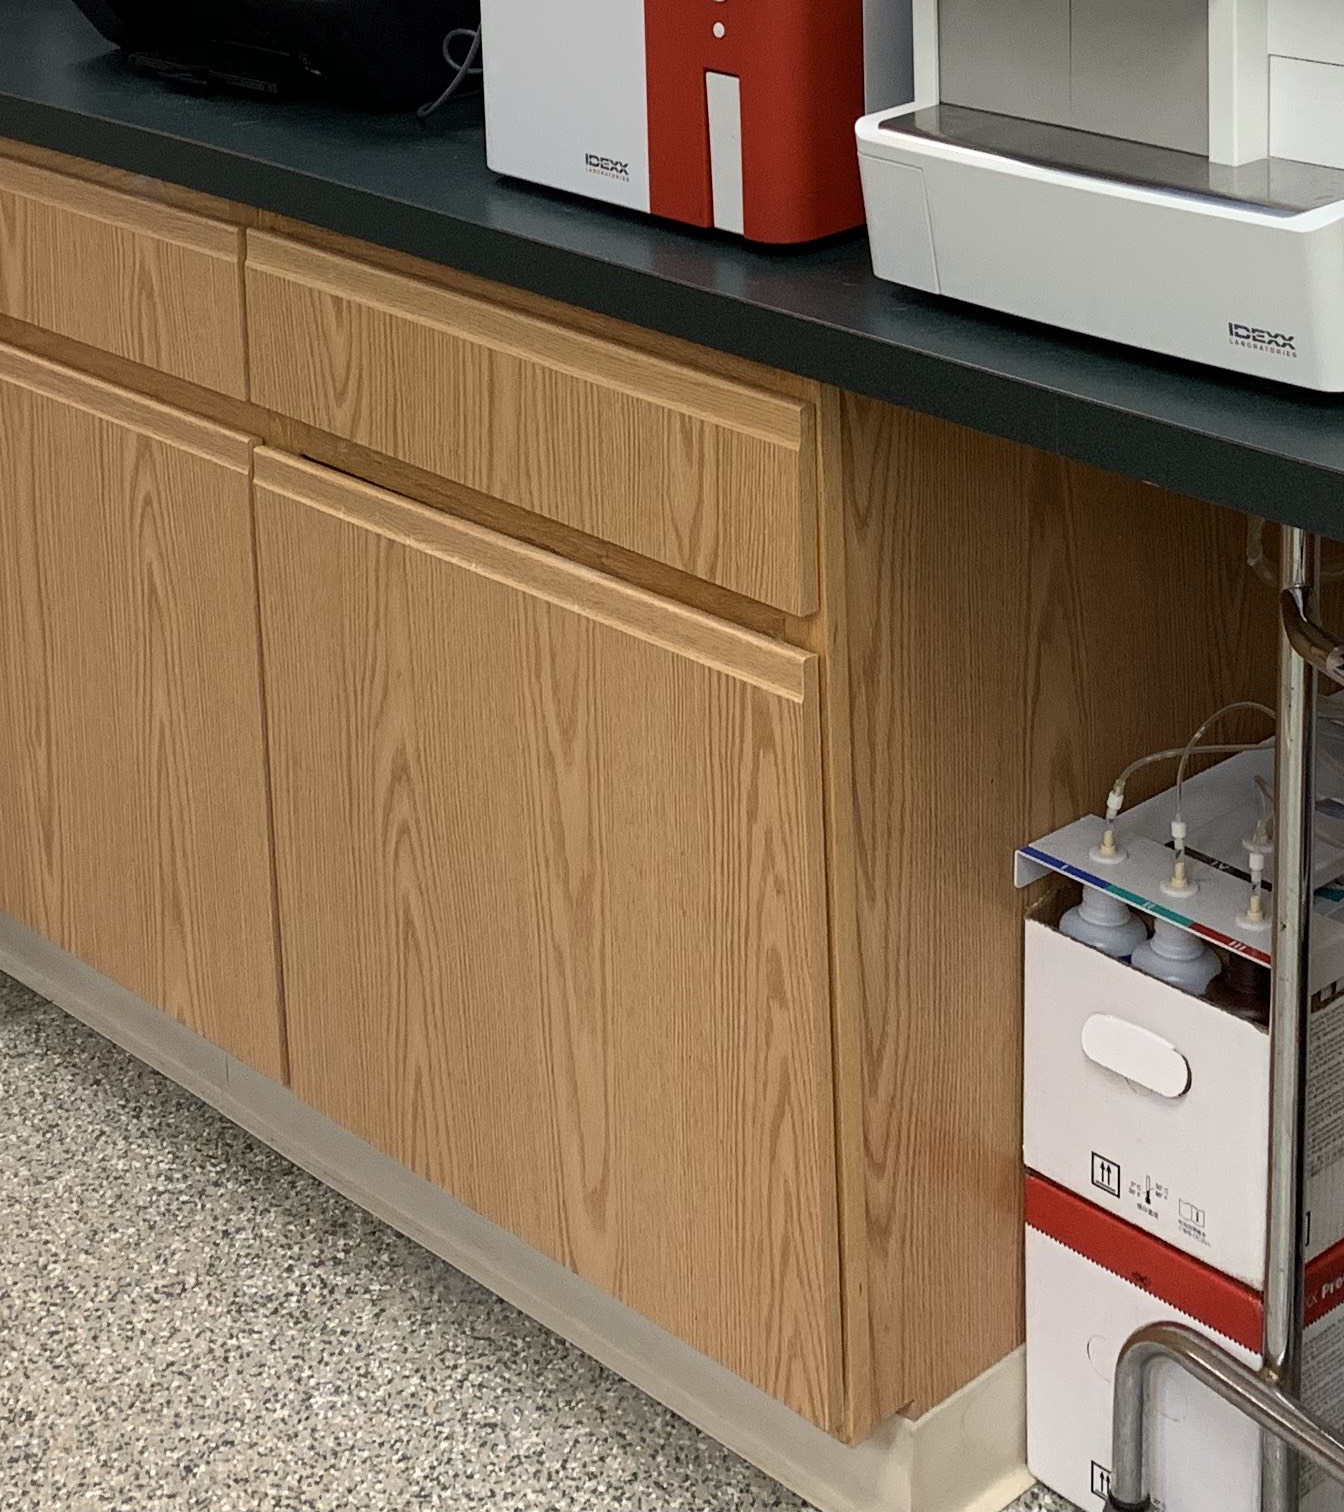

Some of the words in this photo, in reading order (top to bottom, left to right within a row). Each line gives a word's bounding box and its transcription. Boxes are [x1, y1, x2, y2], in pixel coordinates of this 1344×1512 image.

[585, 153, 629, 176] IDEXX
[1228, 322, 1296, 350] IDEXX
[1229, 338, 1297, 358] LABORATORIES
